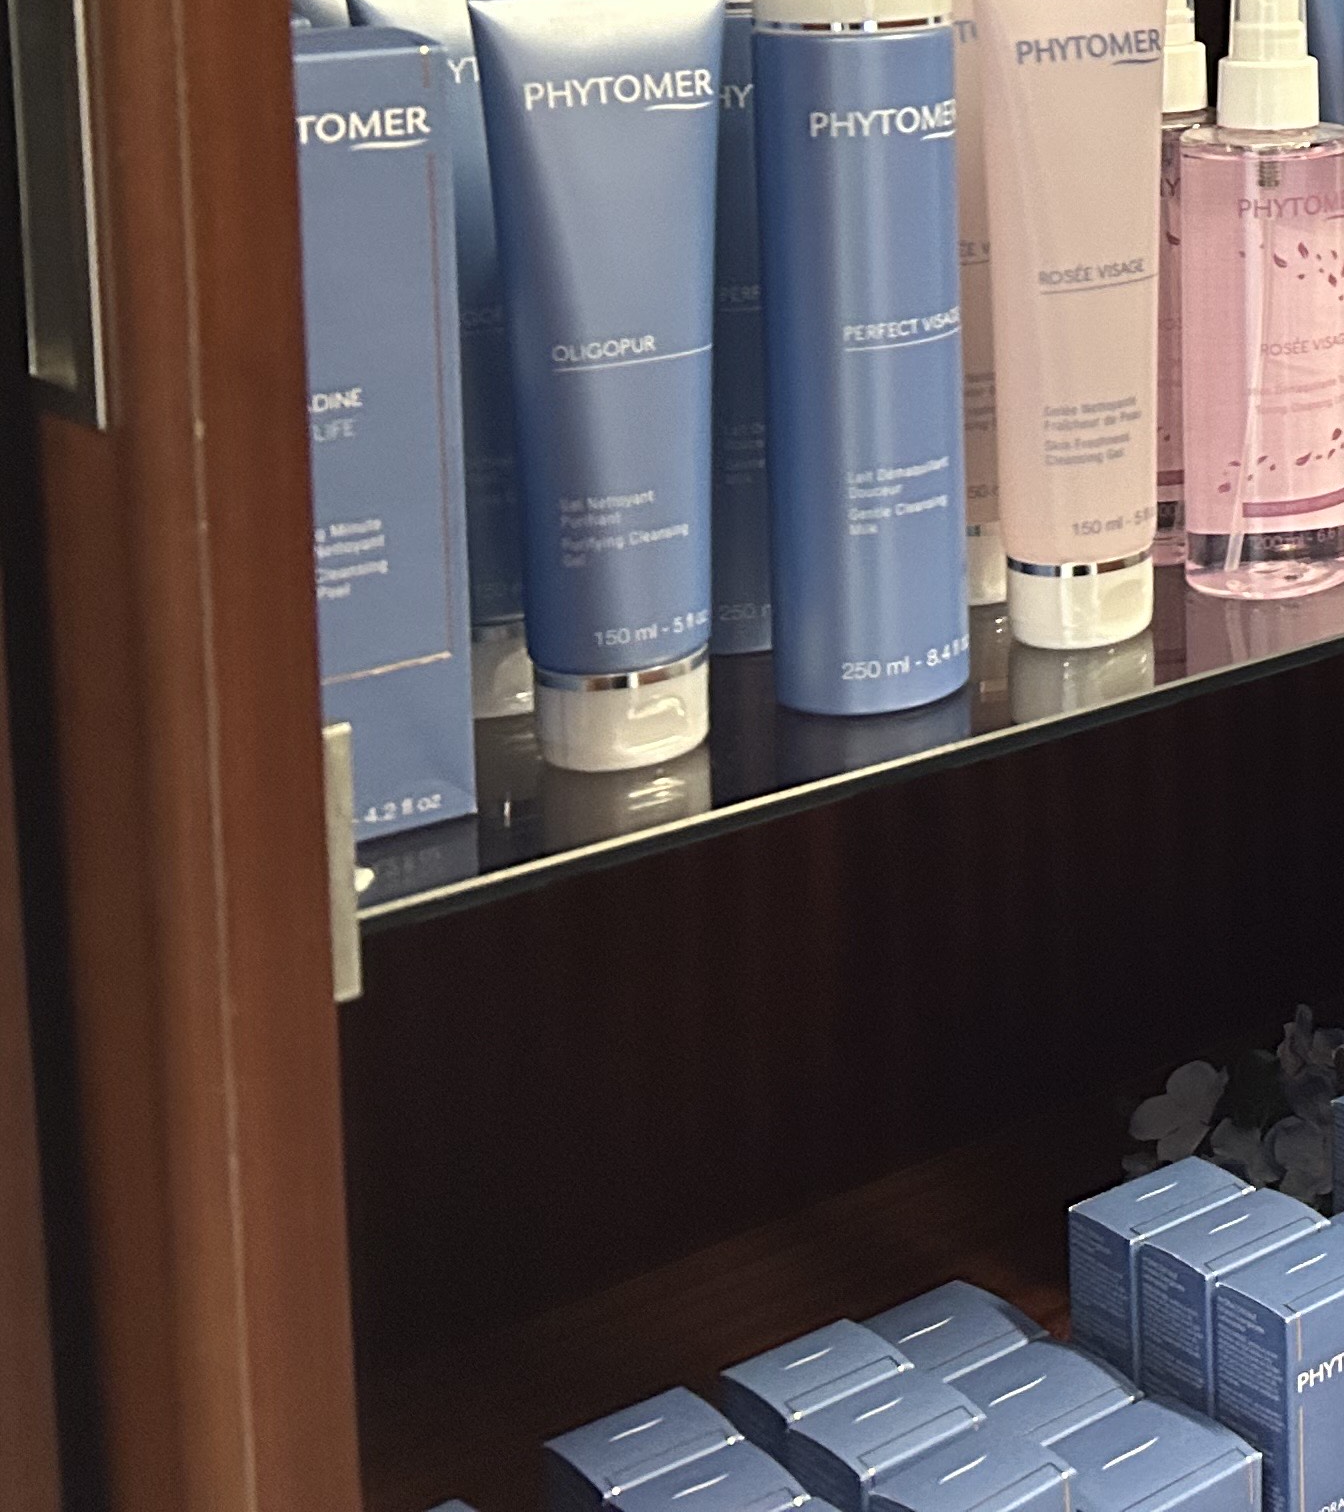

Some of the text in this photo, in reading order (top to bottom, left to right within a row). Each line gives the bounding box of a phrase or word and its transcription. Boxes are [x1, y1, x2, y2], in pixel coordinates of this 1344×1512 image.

[1016, 27, 1162, 65] PHYTOMER
[523, 67, 714, 112] PHYTOMER
[809, 99, 956, 138] PHYTOME
[1099, 257, 1146, 279] VISAGE
[842, 319, 920, 342] PERFECT
[552, 335, 657, 363] OLIGOPUR
[1260, 334, 1308, 357] ROSÉE
[309, 388, 363, 412] DINE
[1072, 516, 1102, 536] 150
[594, 626, 632, 646] 150
[635, 625, 659, 641] ml
[840, 661, 881, 681] 250
[886, 656, 910, 675] ml
[364, 803, 396, 825] 4.2
